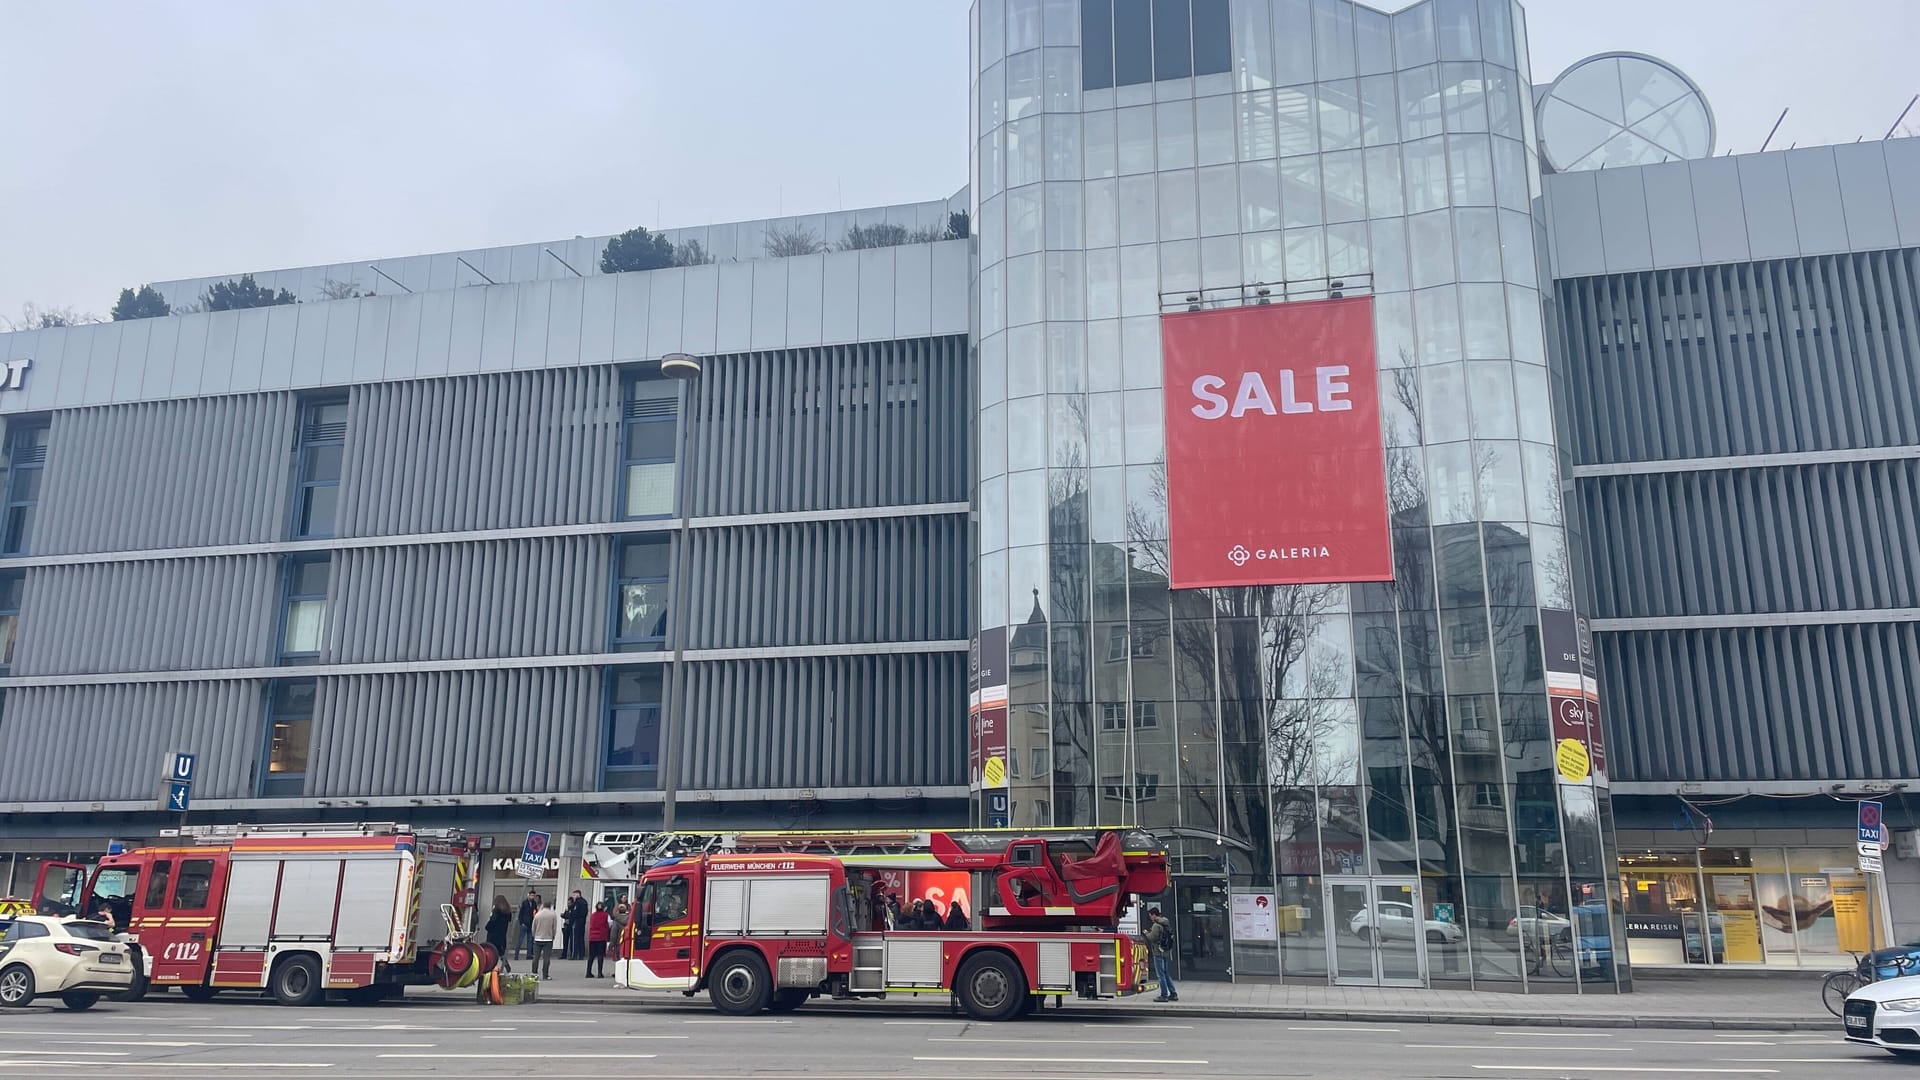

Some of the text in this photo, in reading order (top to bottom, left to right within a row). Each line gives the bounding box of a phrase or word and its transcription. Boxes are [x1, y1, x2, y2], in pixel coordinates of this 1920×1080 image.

[1190, 364, 1352, 420] SALE
[1255, 546, 1330, 560] GALERIA
[1563, 653, 1577, 662] DIE
[178, 757, 191, 777] U
[993, 796, 1006, 812] U
[1860, 828, 1879, 839] TAXI
[525, 852, 543, 864] TAXI
[747, 861, 775, 870] MÜNCHEN
[884, 871, 900, 888] %
[1650, 923, 1679, 931] REISEN
[175, 942, 200, 961] 112
